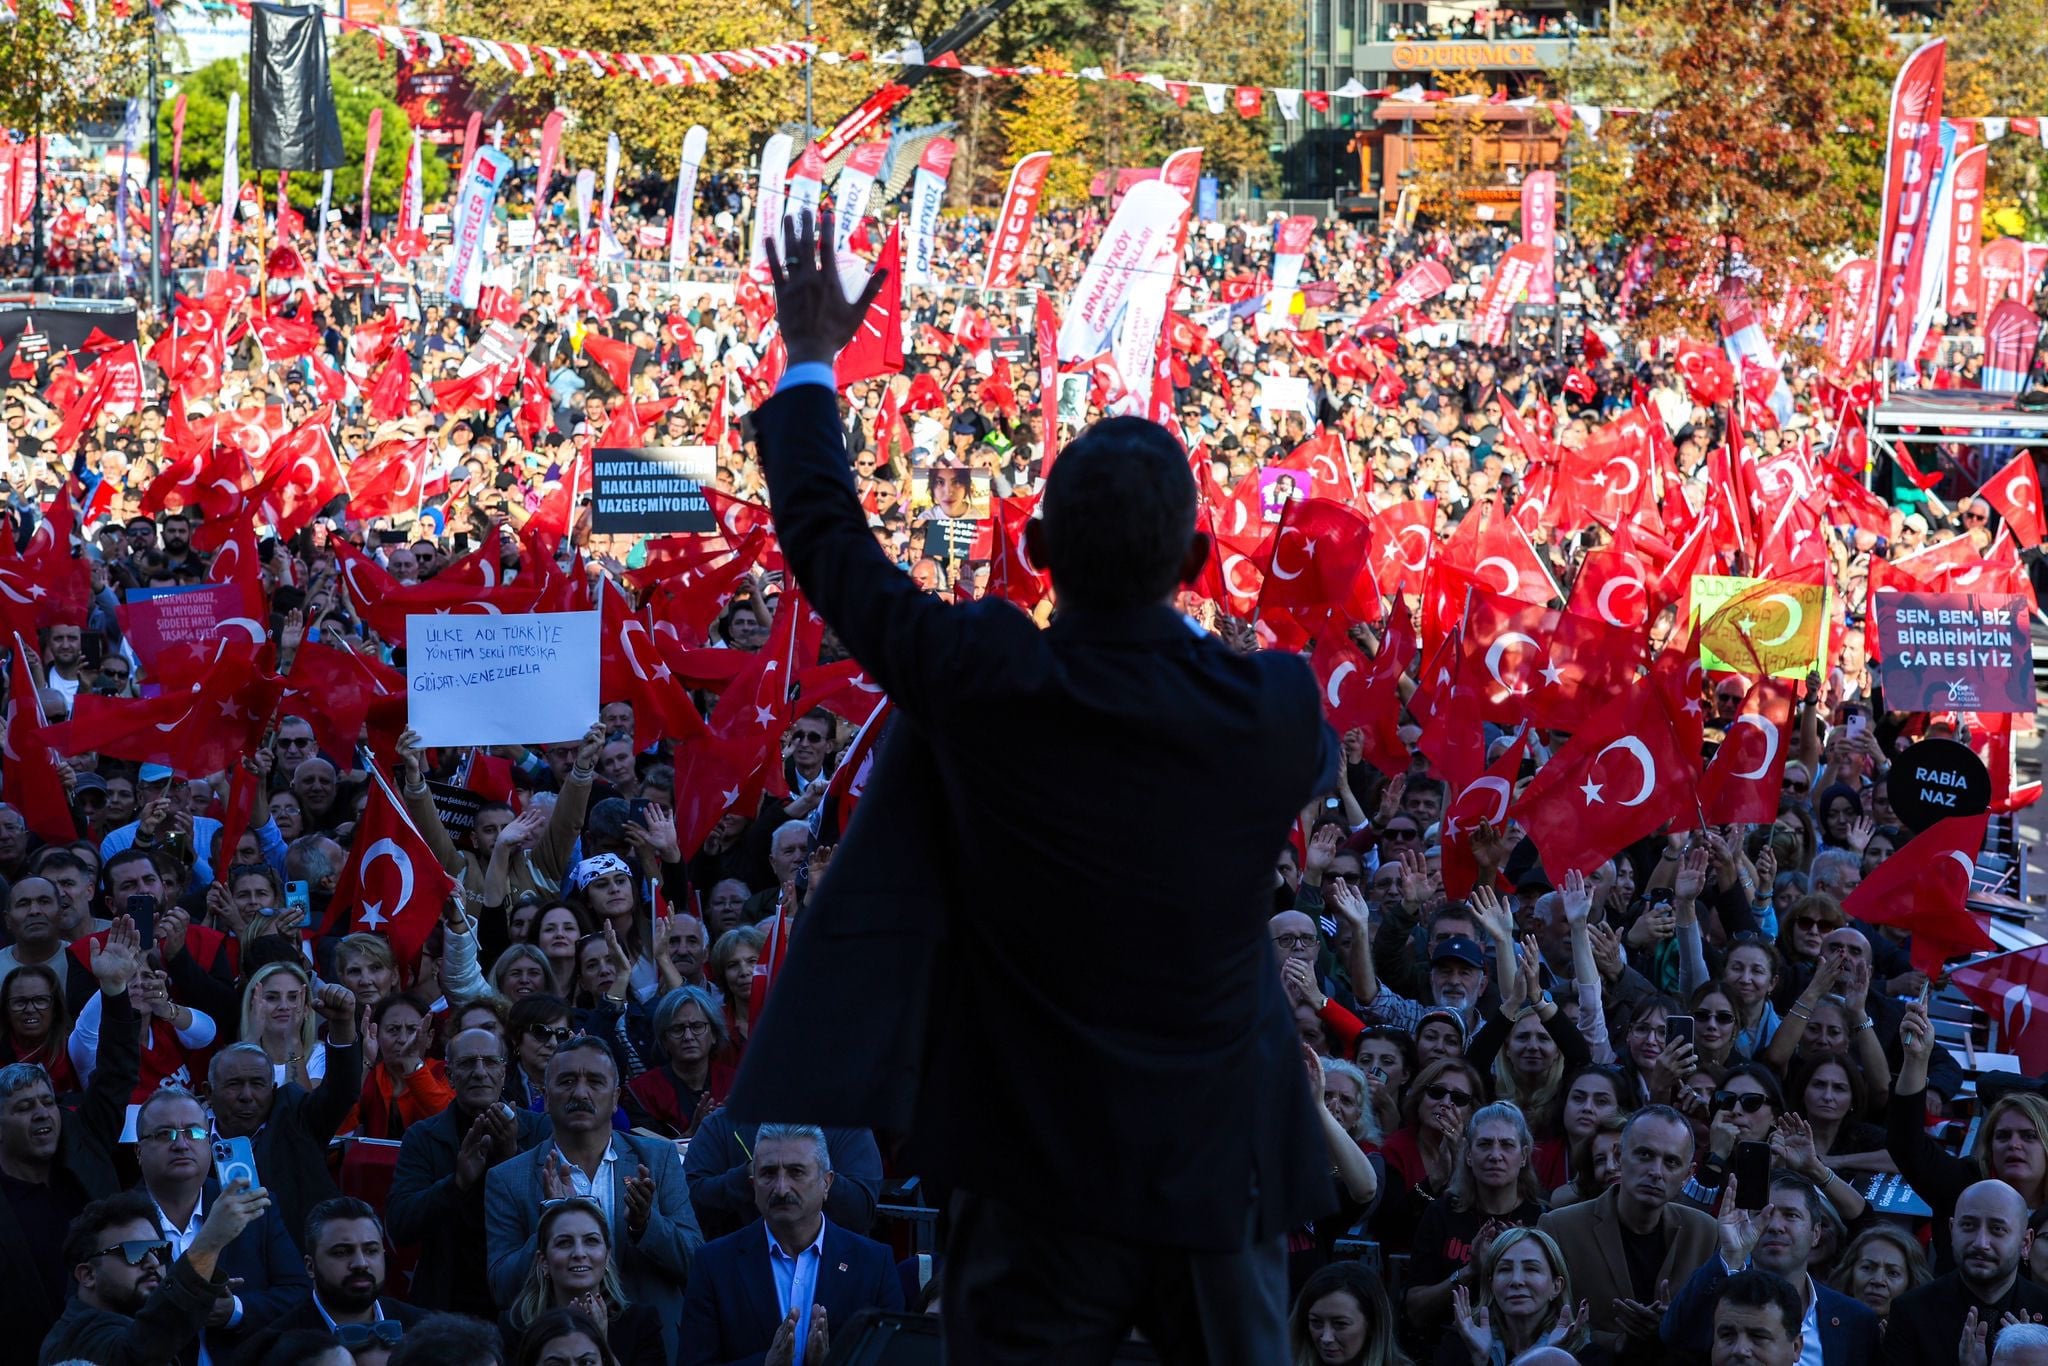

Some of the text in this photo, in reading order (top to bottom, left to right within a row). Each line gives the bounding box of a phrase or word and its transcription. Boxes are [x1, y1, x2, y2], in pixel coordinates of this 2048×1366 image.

[993, 197, 1029, 287] BURSA
[1880, 150, 1921, 347] BURSA
[1952, 203, 1974, 306] BURSA
[601, 479, 706, 495] HAKLARIMIZDAN
[1896, 607, 2011, 627] SEN, BEN, BİZ
[426, 620, 565, 644] ÜLKE ADI TÜRKİYE
[1898, 627, 2012, 646] BİRBİRİMİZİN
[425, 644, 474, 662] YÖNETİM
[1900, 650, 2012, 668] ÇARESİYİZ
[459, 663, 541, 687] VENEZUELLA
[1915, 766, 1968, 790] RABİA
[1920, 788, 1958, 808] NAZ
